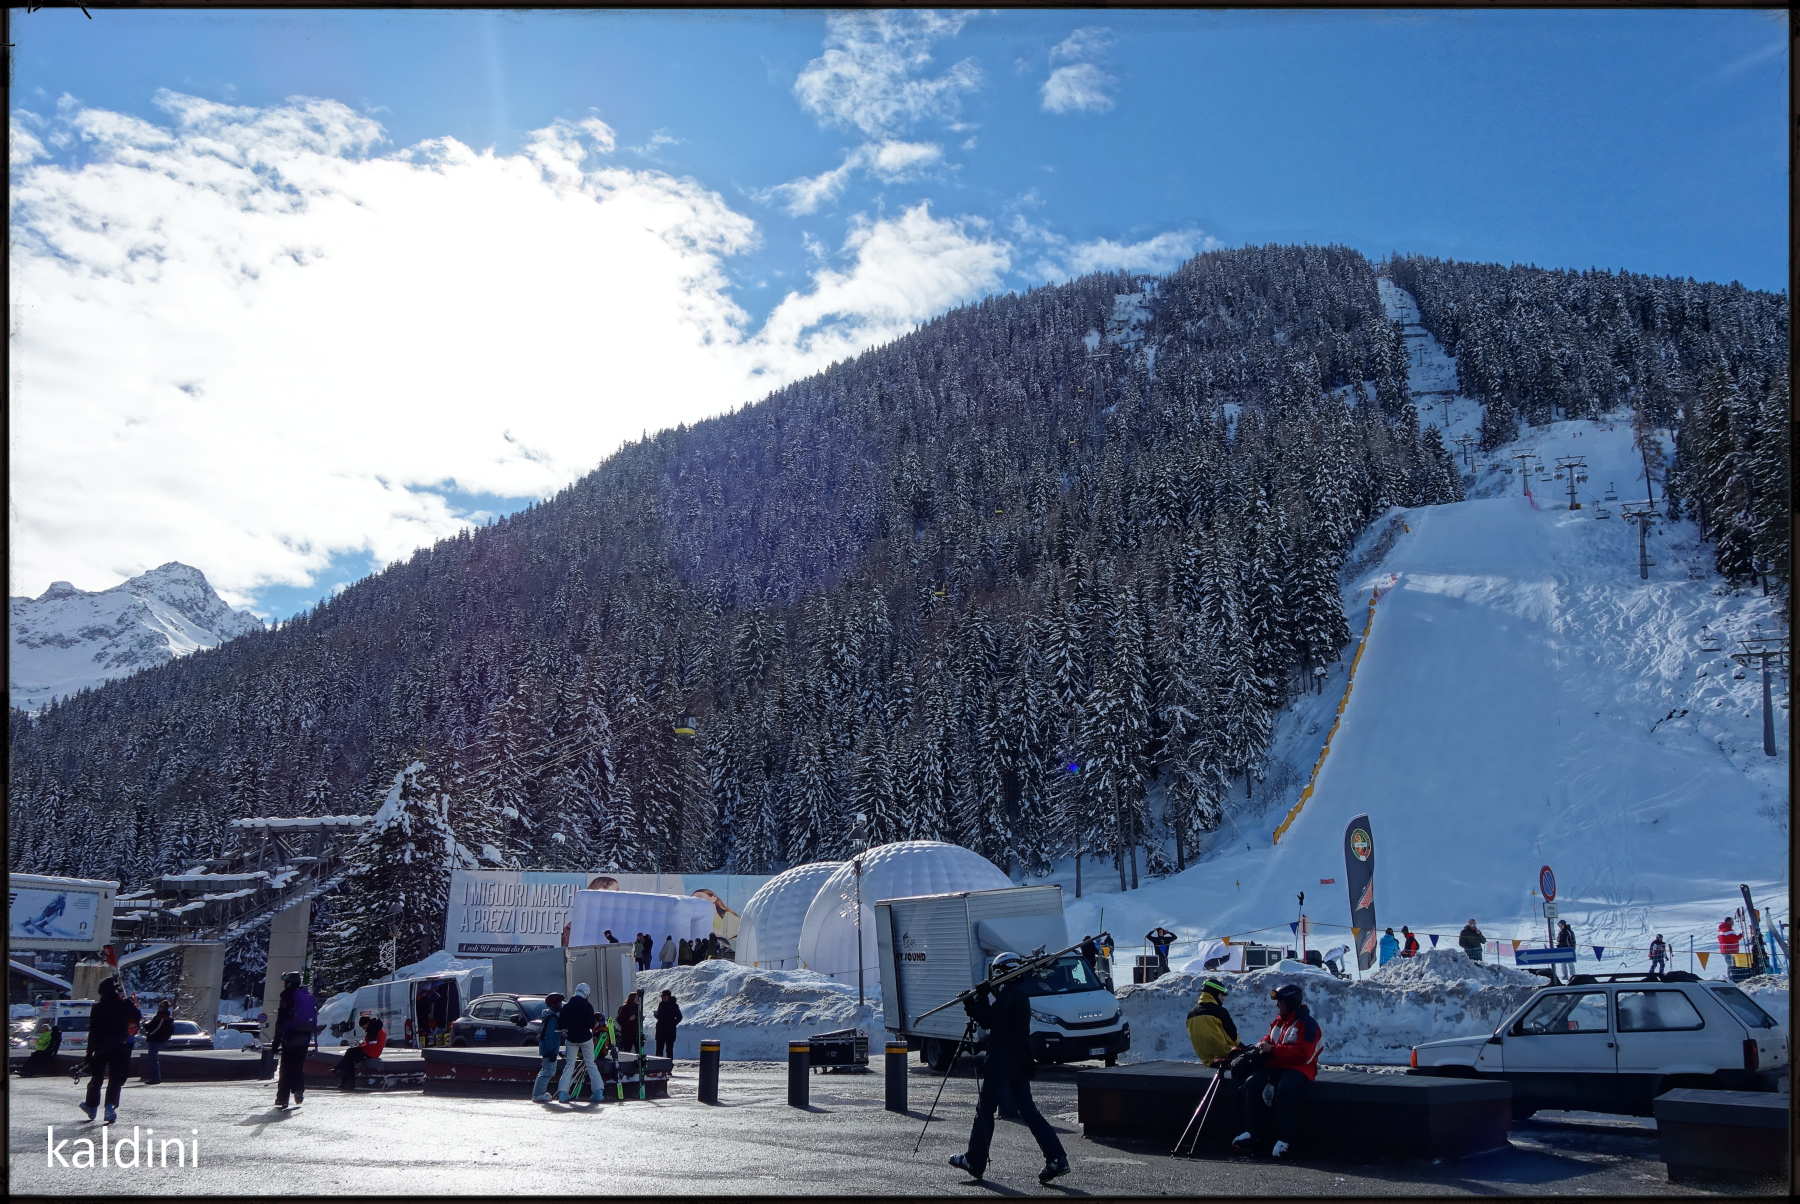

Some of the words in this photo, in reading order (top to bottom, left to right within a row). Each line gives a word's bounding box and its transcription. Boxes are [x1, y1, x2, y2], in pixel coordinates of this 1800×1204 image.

[470, 882, 529, 907] MIGLIORI
[531, 883, 581, 908] MARCH
[460, 908, 470, 933] A
[472, 909, 517, 934] PREZZI
[519, 910, 569, 935] OUTLET
[905, 952, 926, 962] SOUND
